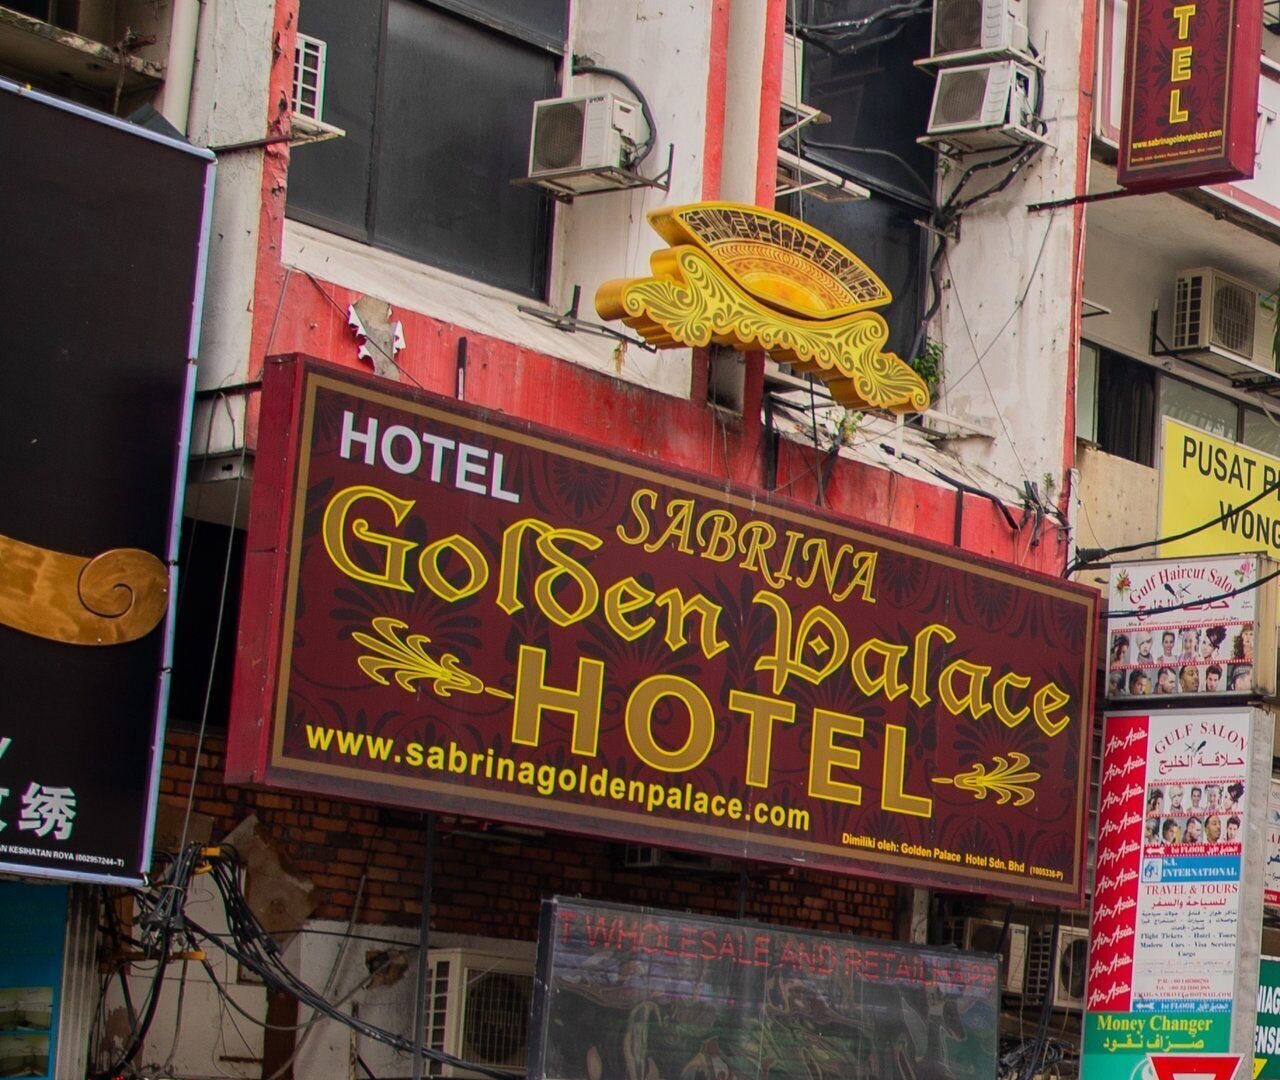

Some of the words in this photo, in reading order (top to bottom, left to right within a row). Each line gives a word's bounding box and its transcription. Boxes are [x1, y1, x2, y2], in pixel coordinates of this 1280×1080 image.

[1132, 129, 1222, 149] www.sabrinagoldenpalace.com
[339, 410, 520, 503] HOTEL
[1183, 435, 1256, 491] PUSAT
[617, 486, 880, 604] SABRINA
[323, 484, 729, 660] Golden
[1129, 577, 1157, 606] Gulf
[1159, 564, 1204, 585] Haircut
[753, 590, 1071, 737] Palace
[512, 644, 934, 818] HOTEL
[1154, 722, 1193, 755] GULF
[1201, 721, 1248, 752] SALON
[306, 723, 811, 831] www.sabrinagoldenpalace.com
[9, 845, 52, 858] KESIHATAN
[53, 850, 74, 861] ROYA
[842, 832, 875, 850] Dimiliki
[900, 842, 932, 858] Golden
[933, 848, 961, 863] Palace
[965, 853, 987, 866] Hotel
[1008, 859, 1025, 873] Bhd
[1180, 846, 1205, 854] FLOOR
[1145, 884, 1187, 896] TRAVEL
[1189, 885, 1197, 895] &
[1200, 883, 1238, 895] TOURS
[1162, 866, 1237, 878] INTERNATIONAL
[585, 916, 770, 967] WHOLESALE
[779, 945, 833, 974] AND
[1097, 1015, 1145, 1035] Money
[1150, 1015, 1213, 1036] Changer
